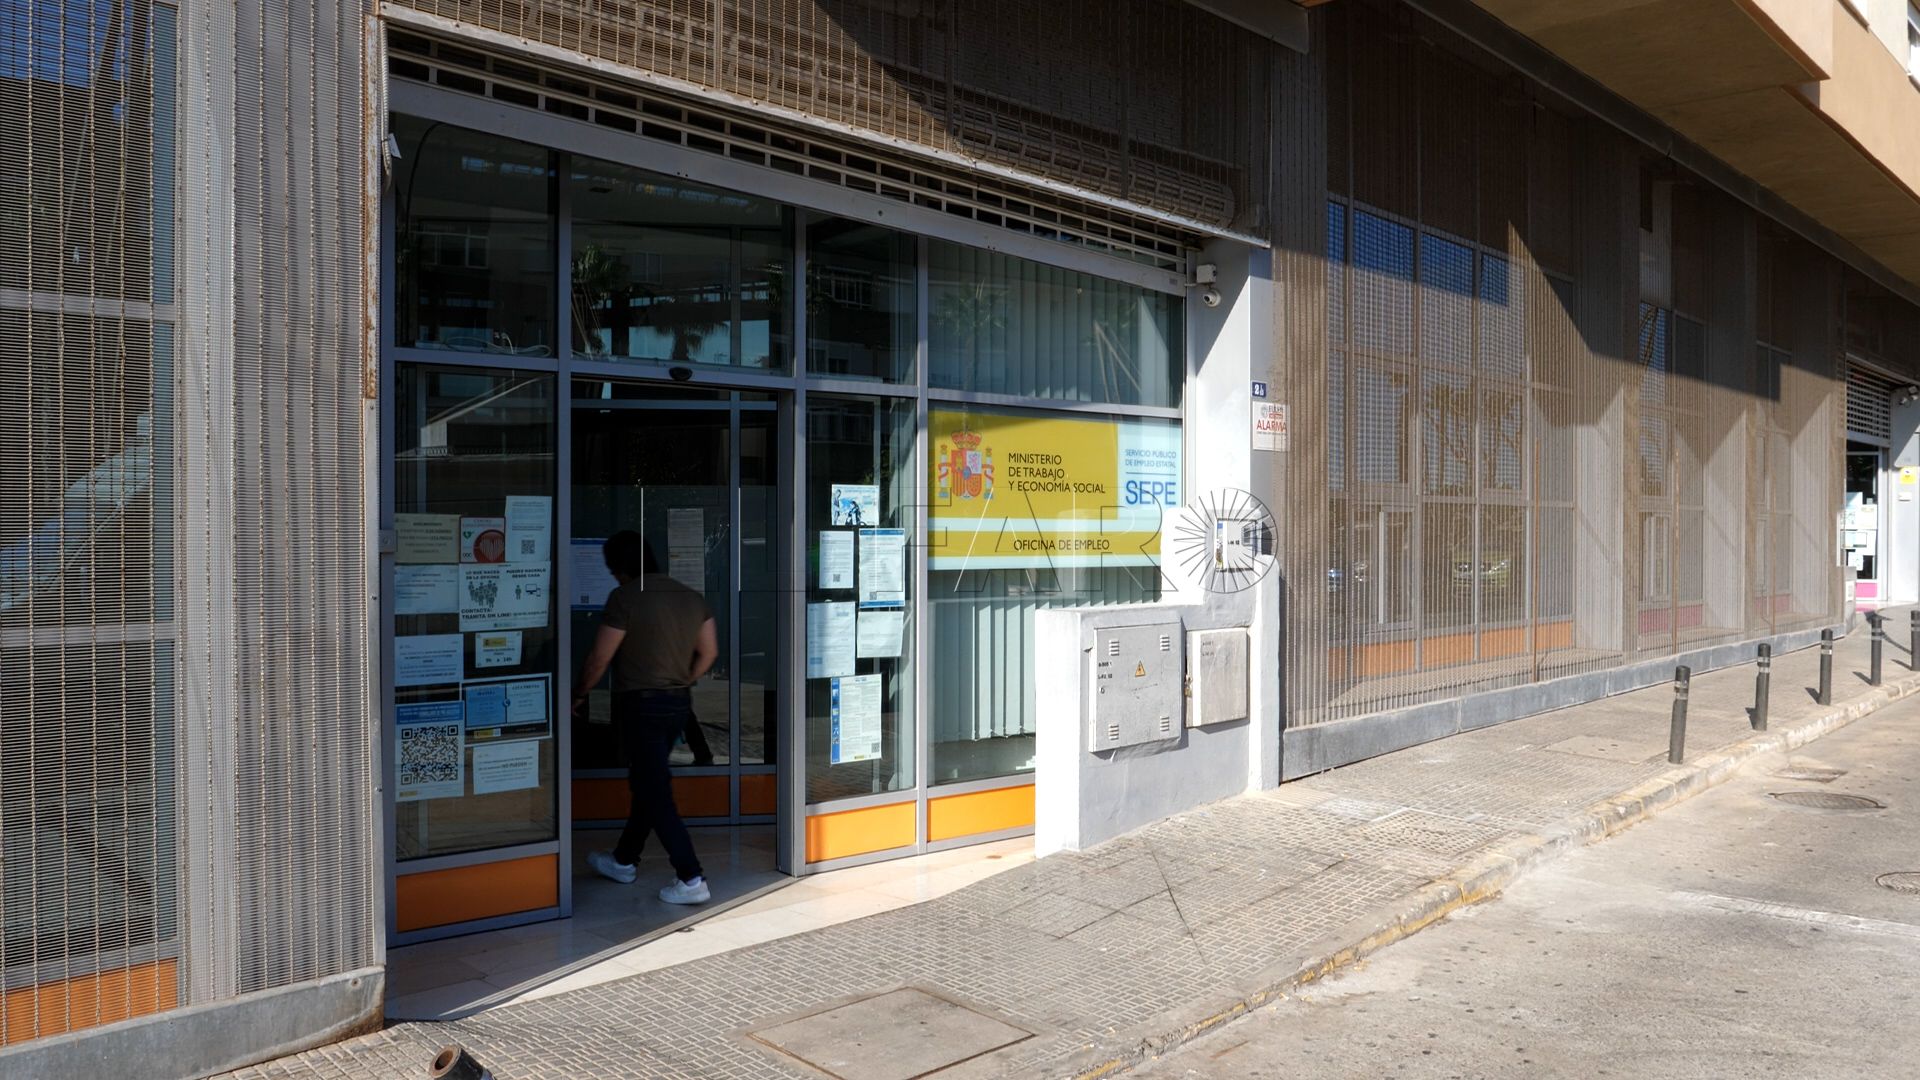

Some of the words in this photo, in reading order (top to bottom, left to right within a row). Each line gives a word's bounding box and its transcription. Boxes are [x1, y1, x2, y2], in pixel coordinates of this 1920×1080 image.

[1256, 419, 1288, 433] ALARMA
[1008, 453, 1062, 466] MINISTERIO
[1125, 449, 1151, 458] SERVICIO
[1125, 458, 1134, 466] DE
[1134, 459, 1155, 467] EMPLEO
[1156, 460, 1177, 468] ESTATAL
[1008, 466, 1022, 477] DE
[1023, 467, 1065, 481] TRABAJO
[1008, 480, 1016, 491] Y
[1017, 480, 1071, 493] ECONOMÍA
[1073, 483, 1106, 494] SOCIAL
[1125, 480, 1177, 505] SEPE
[1013, 539, 1056, 551] OFICINA
[1058, 539, 1072, 550] DE
[1074, 539, 1110, 551] EMPLEO
